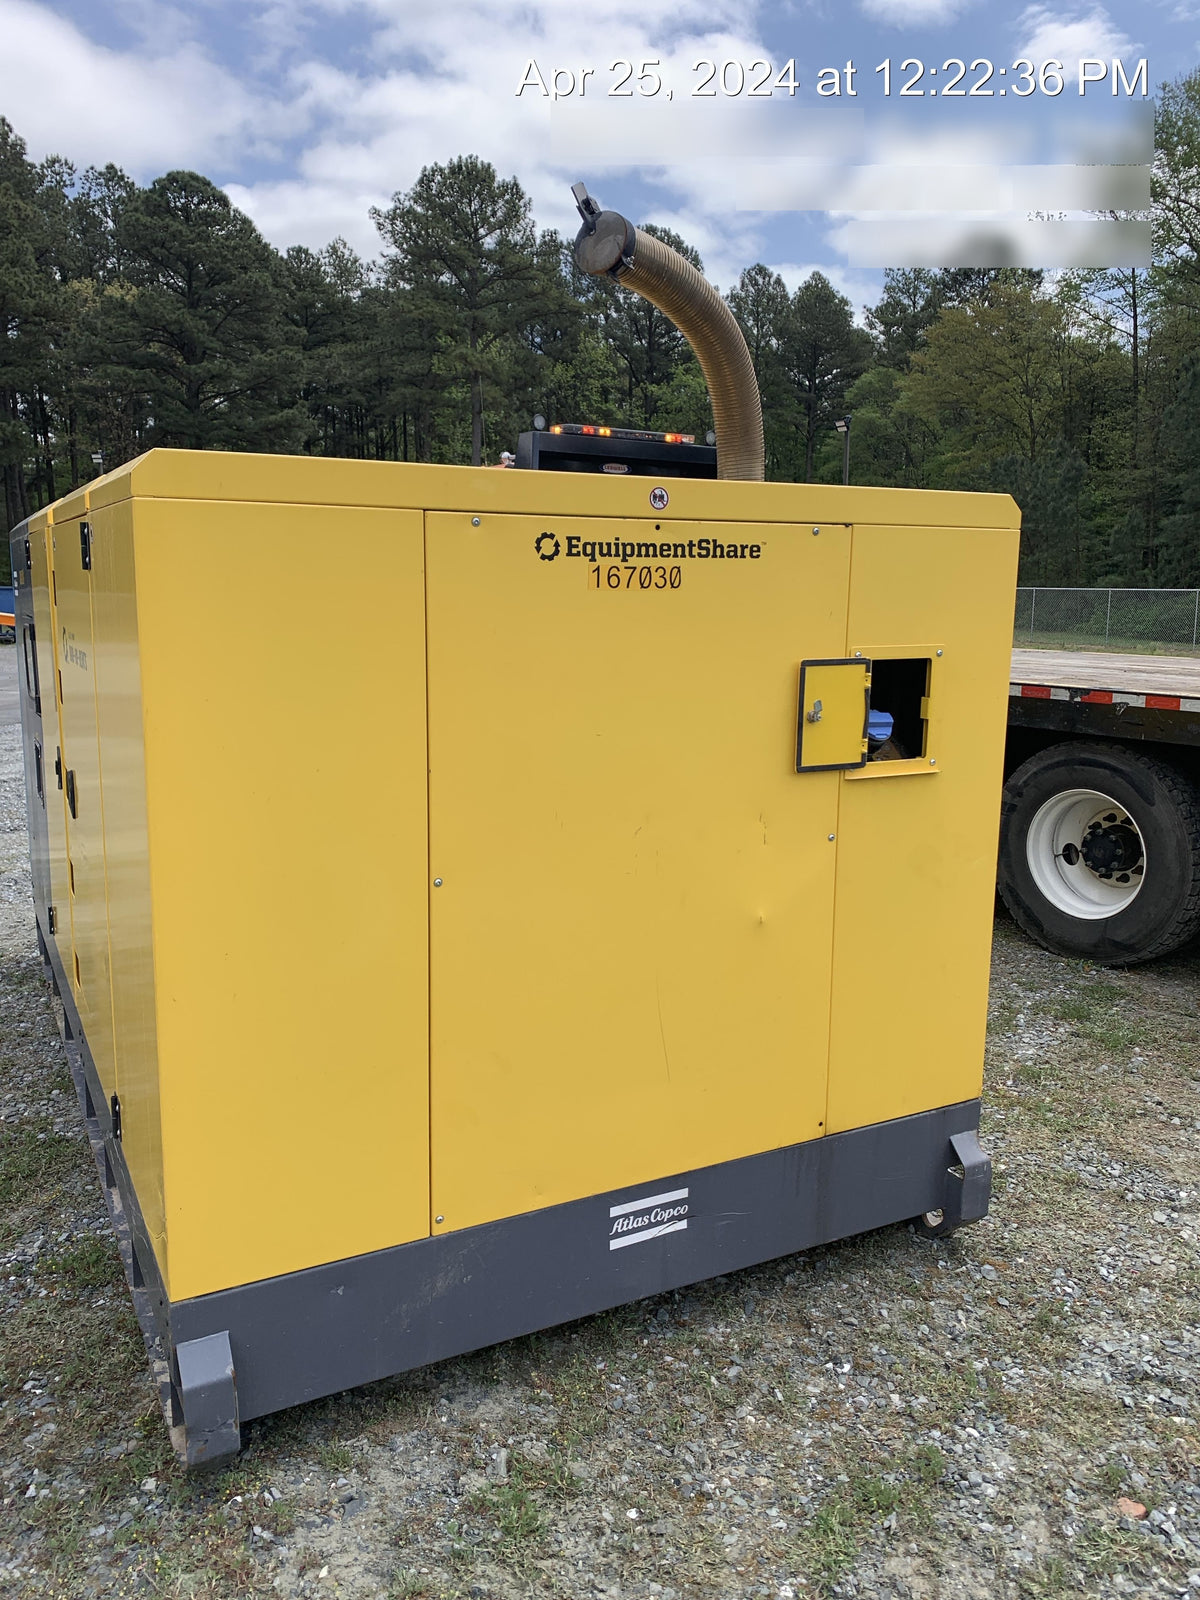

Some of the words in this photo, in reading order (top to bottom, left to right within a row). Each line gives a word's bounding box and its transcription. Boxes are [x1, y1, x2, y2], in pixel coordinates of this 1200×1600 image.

[565, 536, 761, 562] EquipmentShare
[592, 565, 682, 589] 167030
[609, 1215, 650, 1235] Atlas
[650, 1204, 689, 1223] Copco
